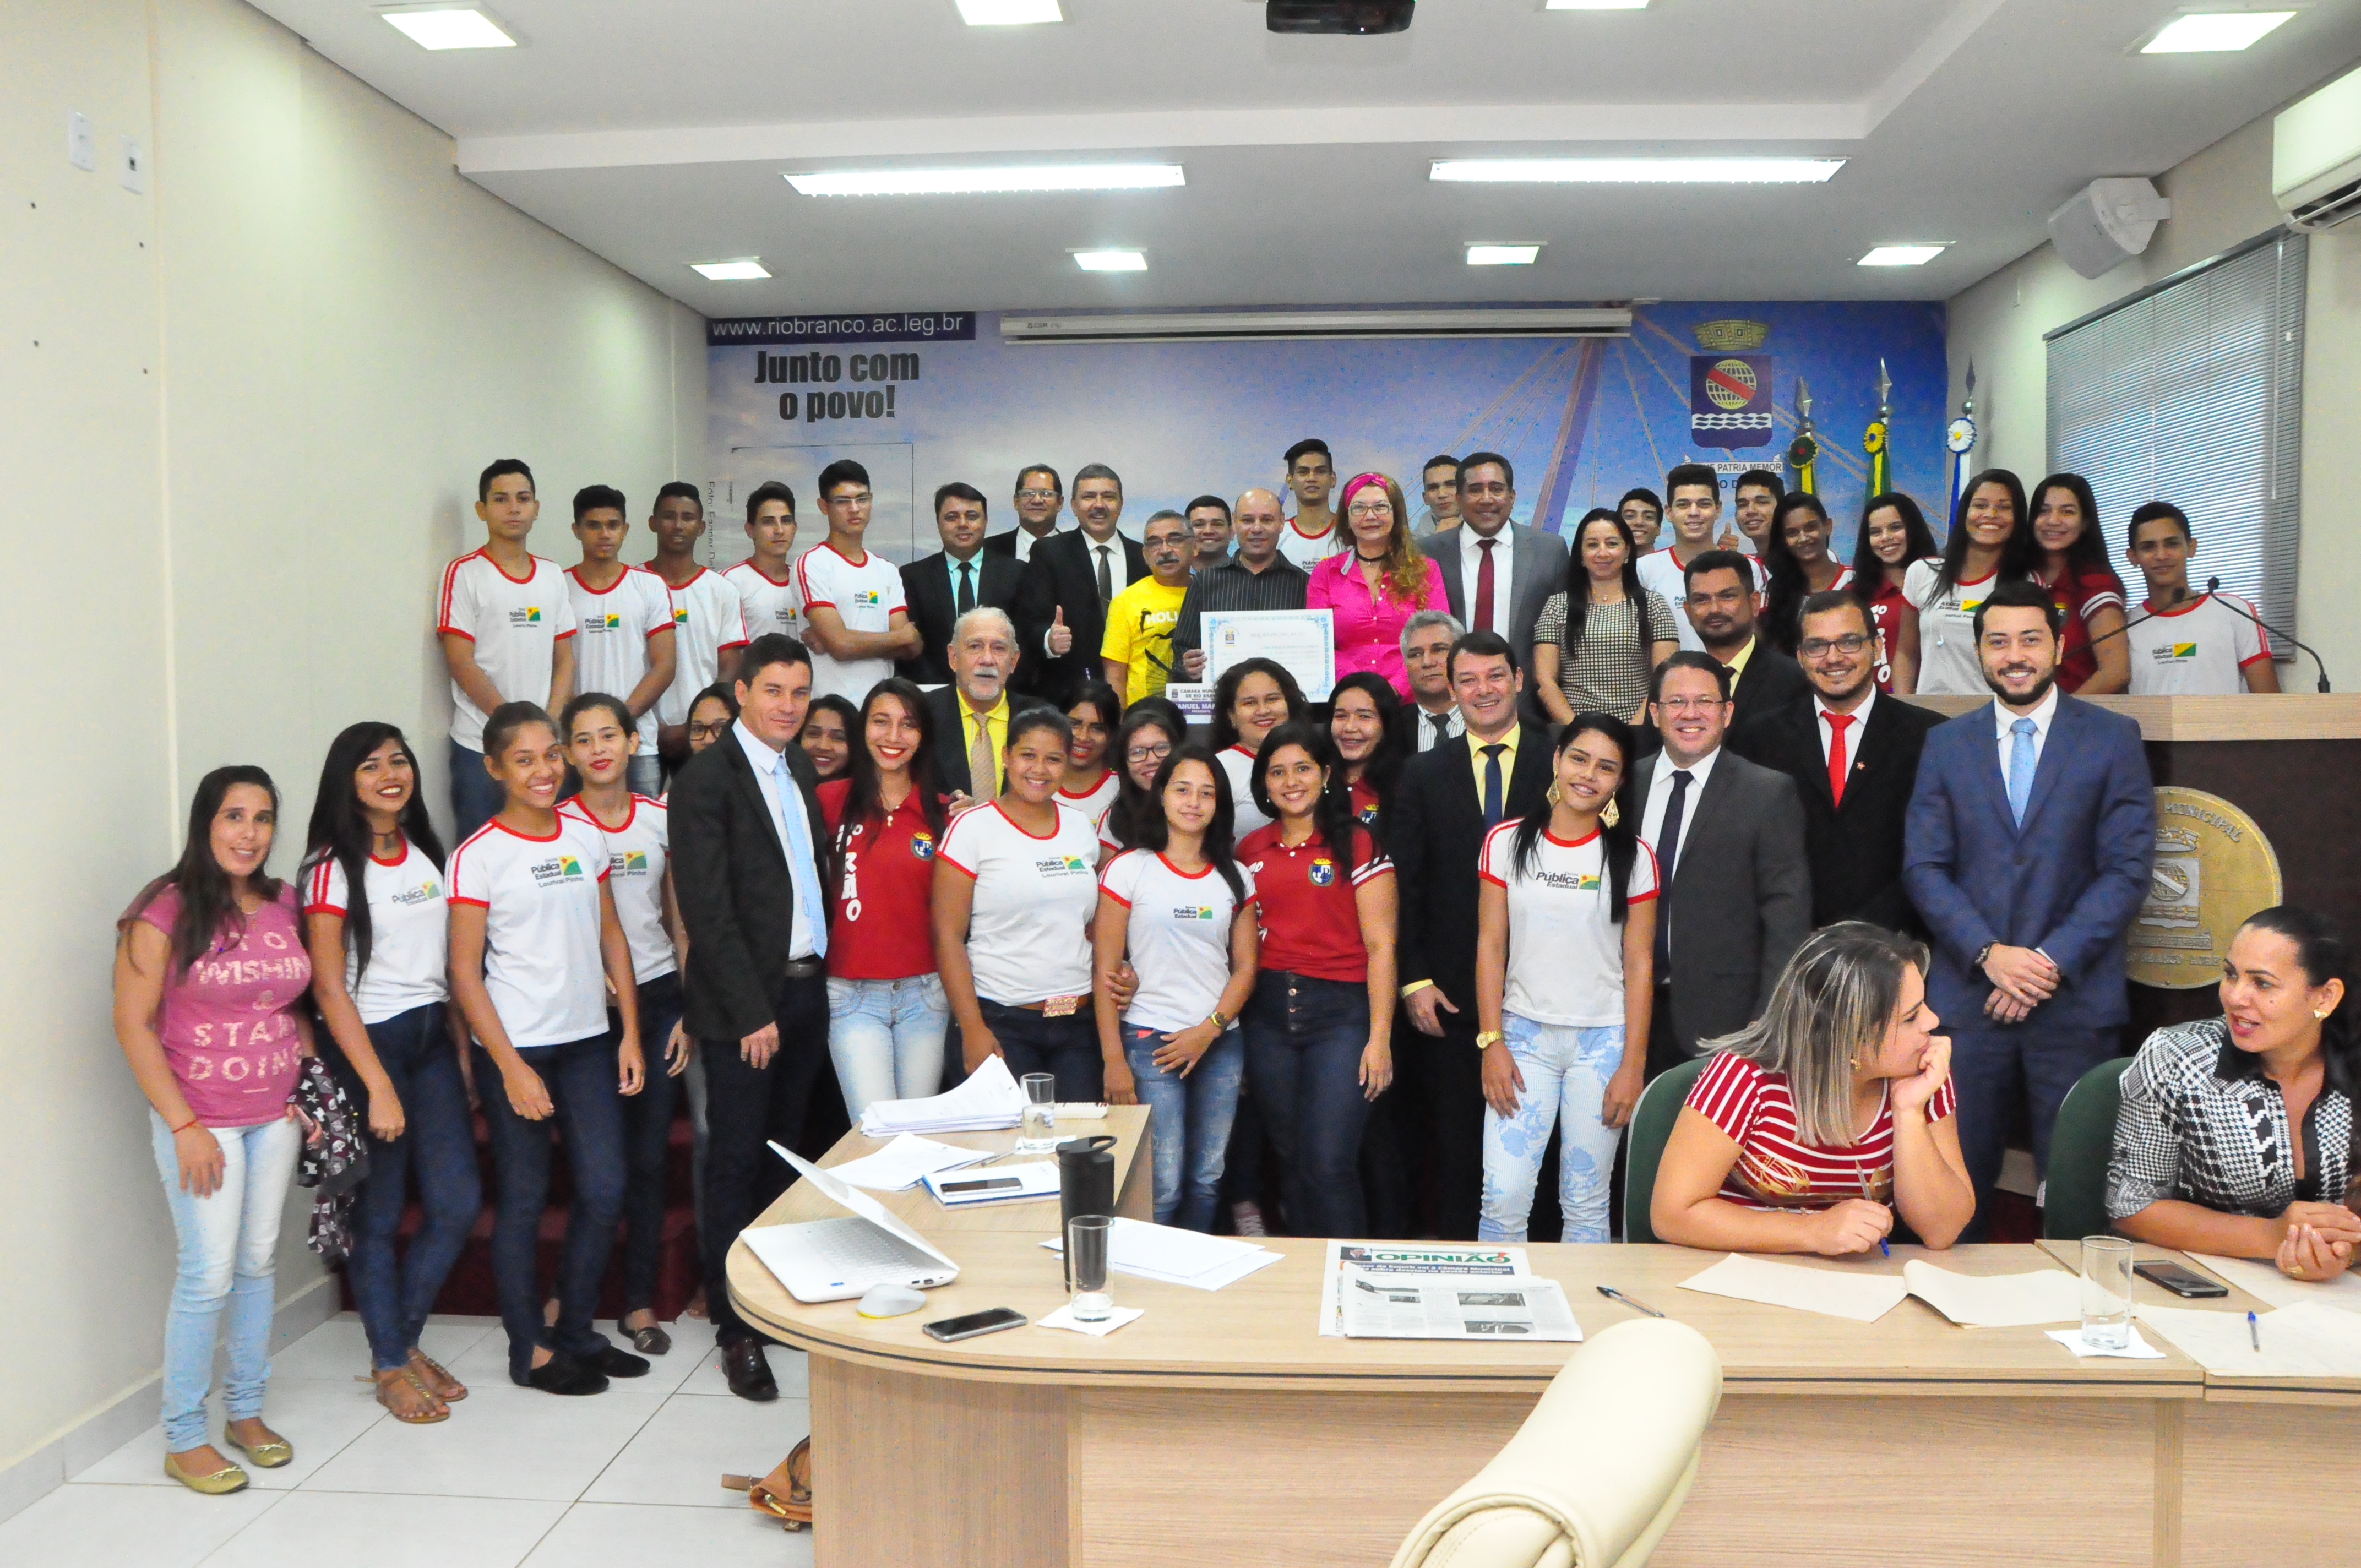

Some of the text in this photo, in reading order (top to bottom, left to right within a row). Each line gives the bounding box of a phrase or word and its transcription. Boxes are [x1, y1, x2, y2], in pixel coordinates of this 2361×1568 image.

[713, 313, 963, 336] www.riobranco.ac.leg.br
[754, 350, 920, 384] Junto com
[779, 385, 895, 423] o povo!
[1717, 464, 1748, 472] PATRIA
[1749, 462, 1782, 472] MEMOR
[531, 863, 561, 874] Pública
[1536, 871, 1580, 885] Pública
[1546, 881, 1579, 890] Estadual
[1375, 1252, 1511, 1264] OPINIÃO
